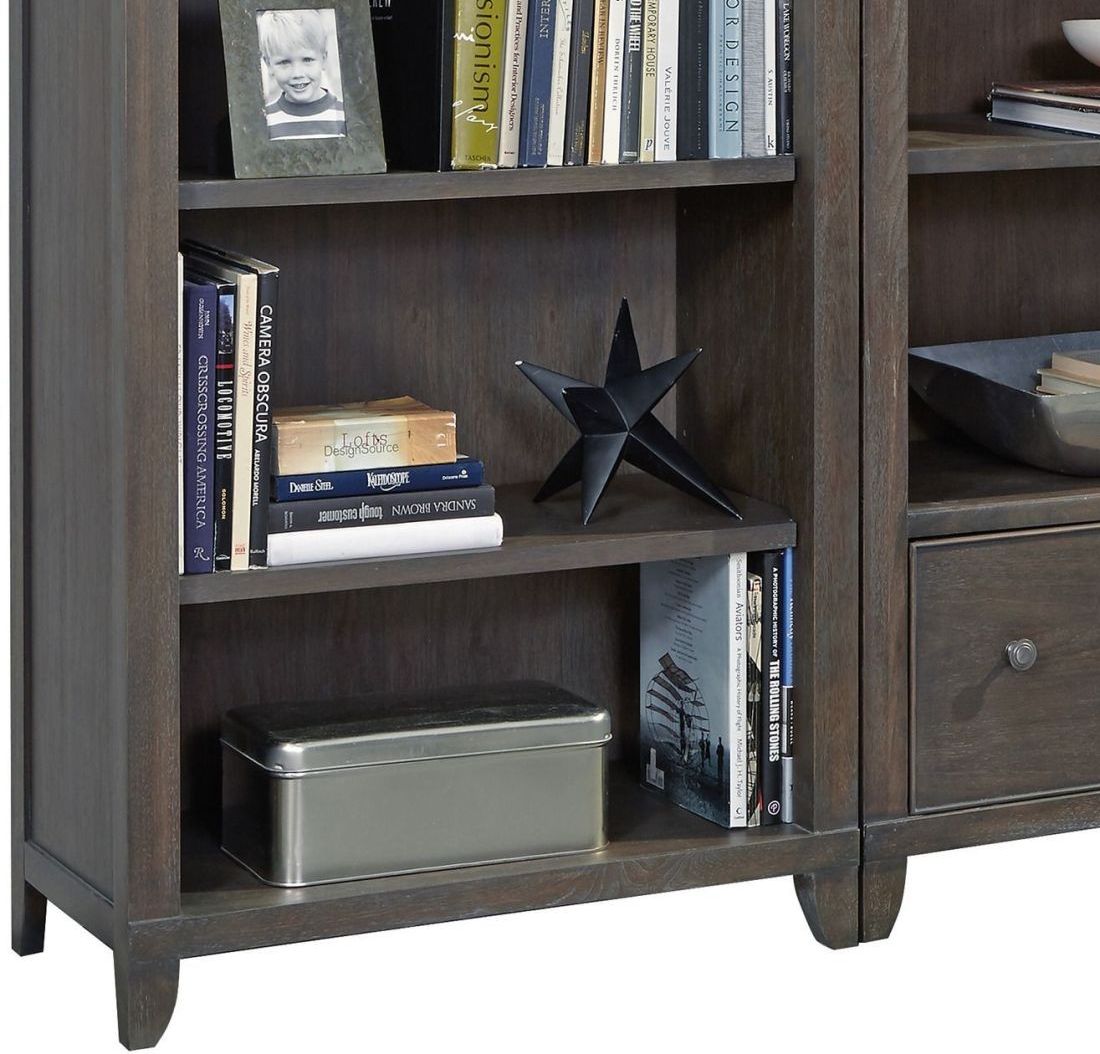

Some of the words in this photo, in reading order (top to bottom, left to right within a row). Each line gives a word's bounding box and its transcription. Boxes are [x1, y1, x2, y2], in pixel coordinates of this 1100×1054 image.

[630, 7, 642, 23] THE
[514, 17, 522, 49] Practices
[629, 25, 640, 52] WHEEL
[510, 64, 519, 92] Interior
[646, 47, 656, 77] HOUSE
[664, 67, 673, 112] VALÉRIE
[726, 40, 739, 132] DESIGN
[507, 93, 517, 131] Designers
[258, 305, 272, 367] CAMERA
[197, 355, 208, 463] CRISSCROSSING
[216, 380, 233, 460] LOCOMOTIVE
[254, 371, 269, 442] OBSCURA
[324, 443, 398, 458] DesignSource
[195, 466, 206, 528] AMERICA
[359, 502, 383, 521] tough
[392, 505, 430, 516] BROWN
[433, 499, 476, 513] SANDRA
[318, 509, 358, 522] customer
[735, 603, 744, 641] Aviators
[770, 660, 779, 679] THE
[770, 680, 779, 721] ROLLING
[769, 723, 779, 762] STONES
